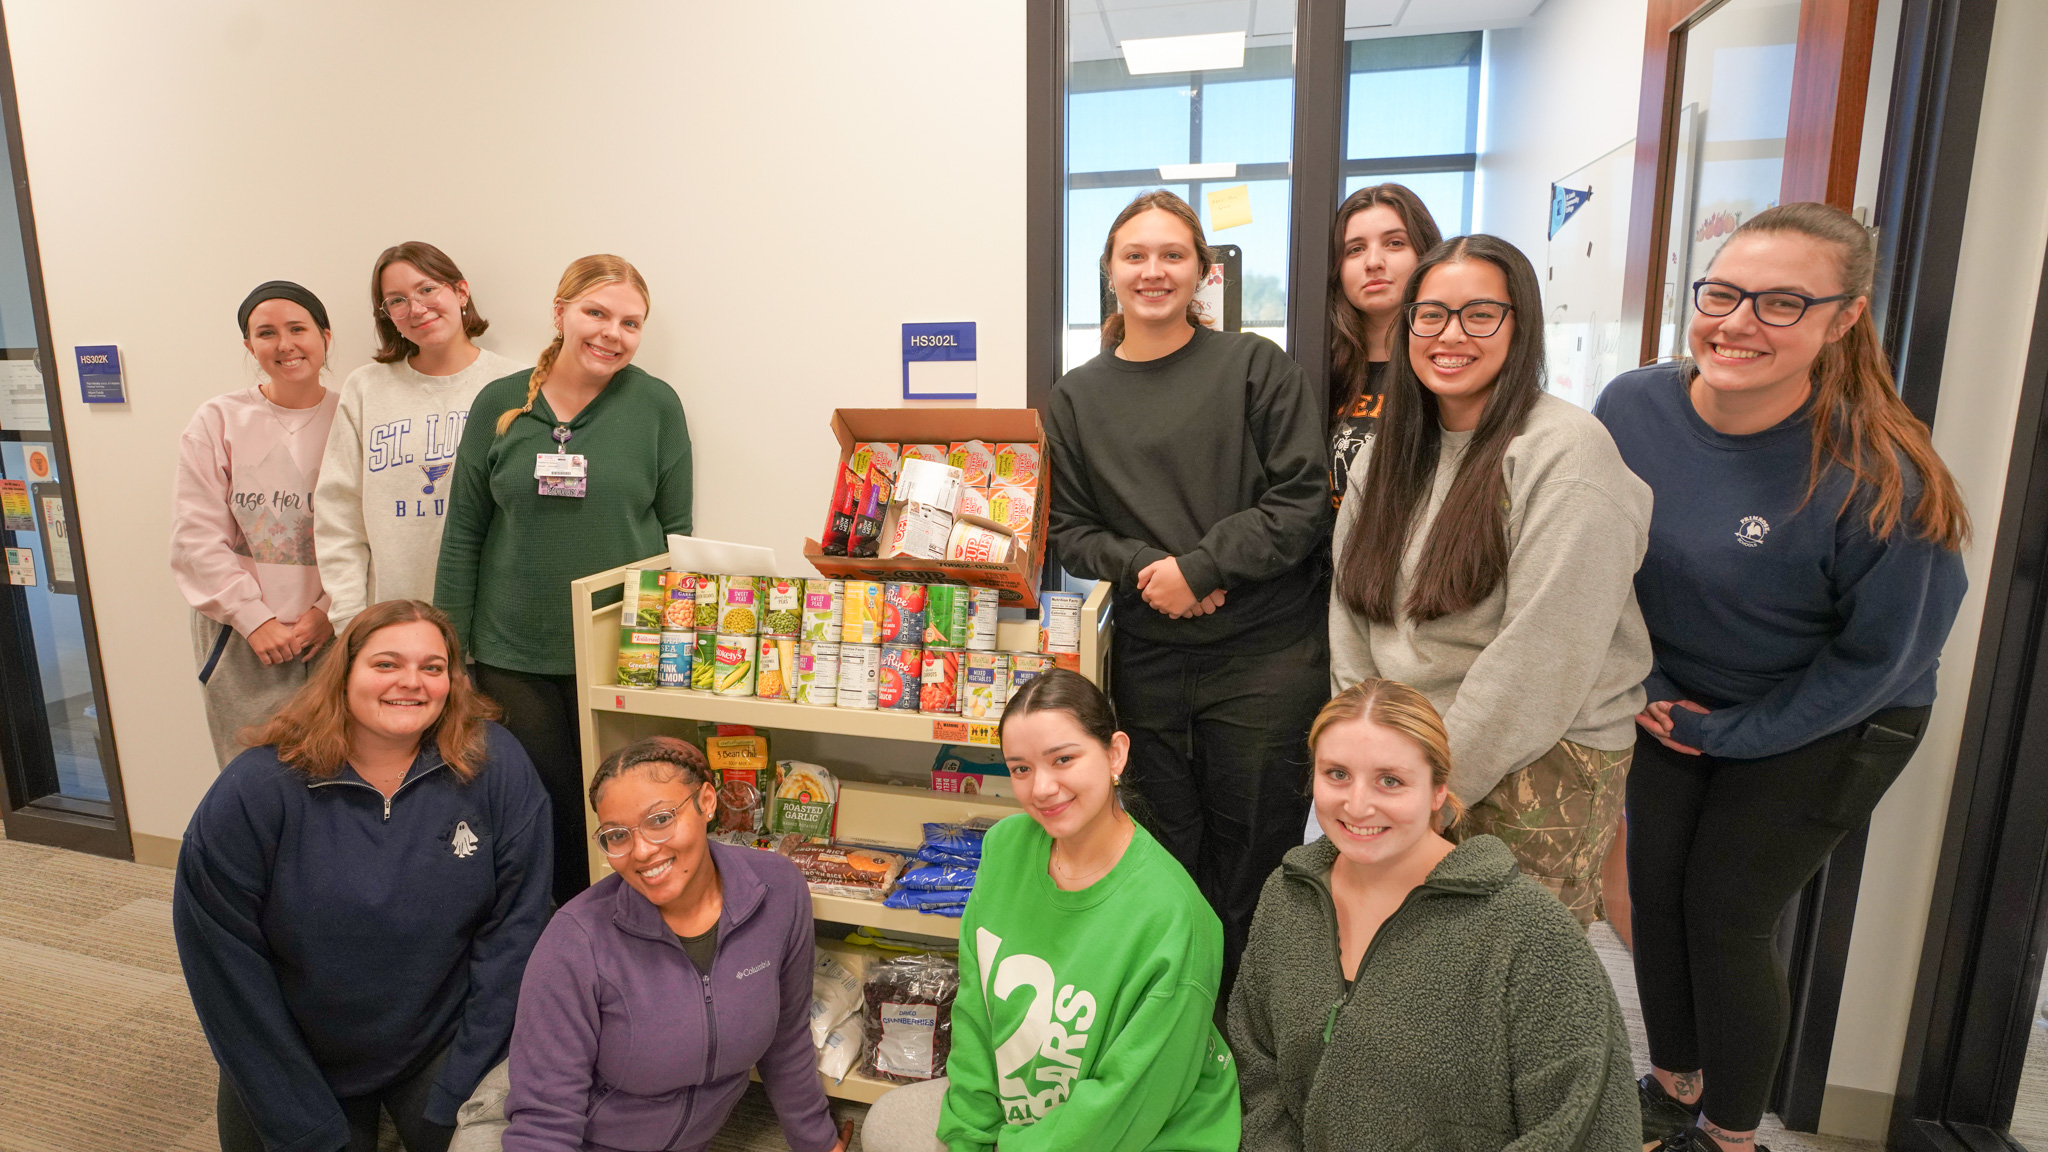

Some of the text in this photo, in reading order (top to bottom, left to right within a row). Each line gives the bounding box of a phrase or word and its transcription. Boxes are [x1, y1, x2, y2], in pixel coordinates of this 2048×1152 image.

[911, 335, 958, 347] HS302L
[80, 354, 109, 364] HS302K
[369, 411, 469, 473] ST. LOU
[229, 490, 267, 512] ase
[273, 490, 302, 513] Her
[396, 499, 445, 517] BLU
[887, 588, 909, 607] Ripe
[660, 645, 677, 653] SEA
[628, 661, 646, 669] Green
[660, 663, 677, 673] PINK
[973, 669, 987, 677] MIXED
[968, 674, 992, 683] VEGETABLES
[879, 692, 892, 701] auce
[722, 751, 740, 759] Bean
[947, 762, 958, 771] 48
[783, 803, 823, 815] ROASTED
[785, 811, 819, 822] GARLIC
[743, 959, 771, 977] Columbia
[882, 1017, 935, 1027] CRANBERRIES
